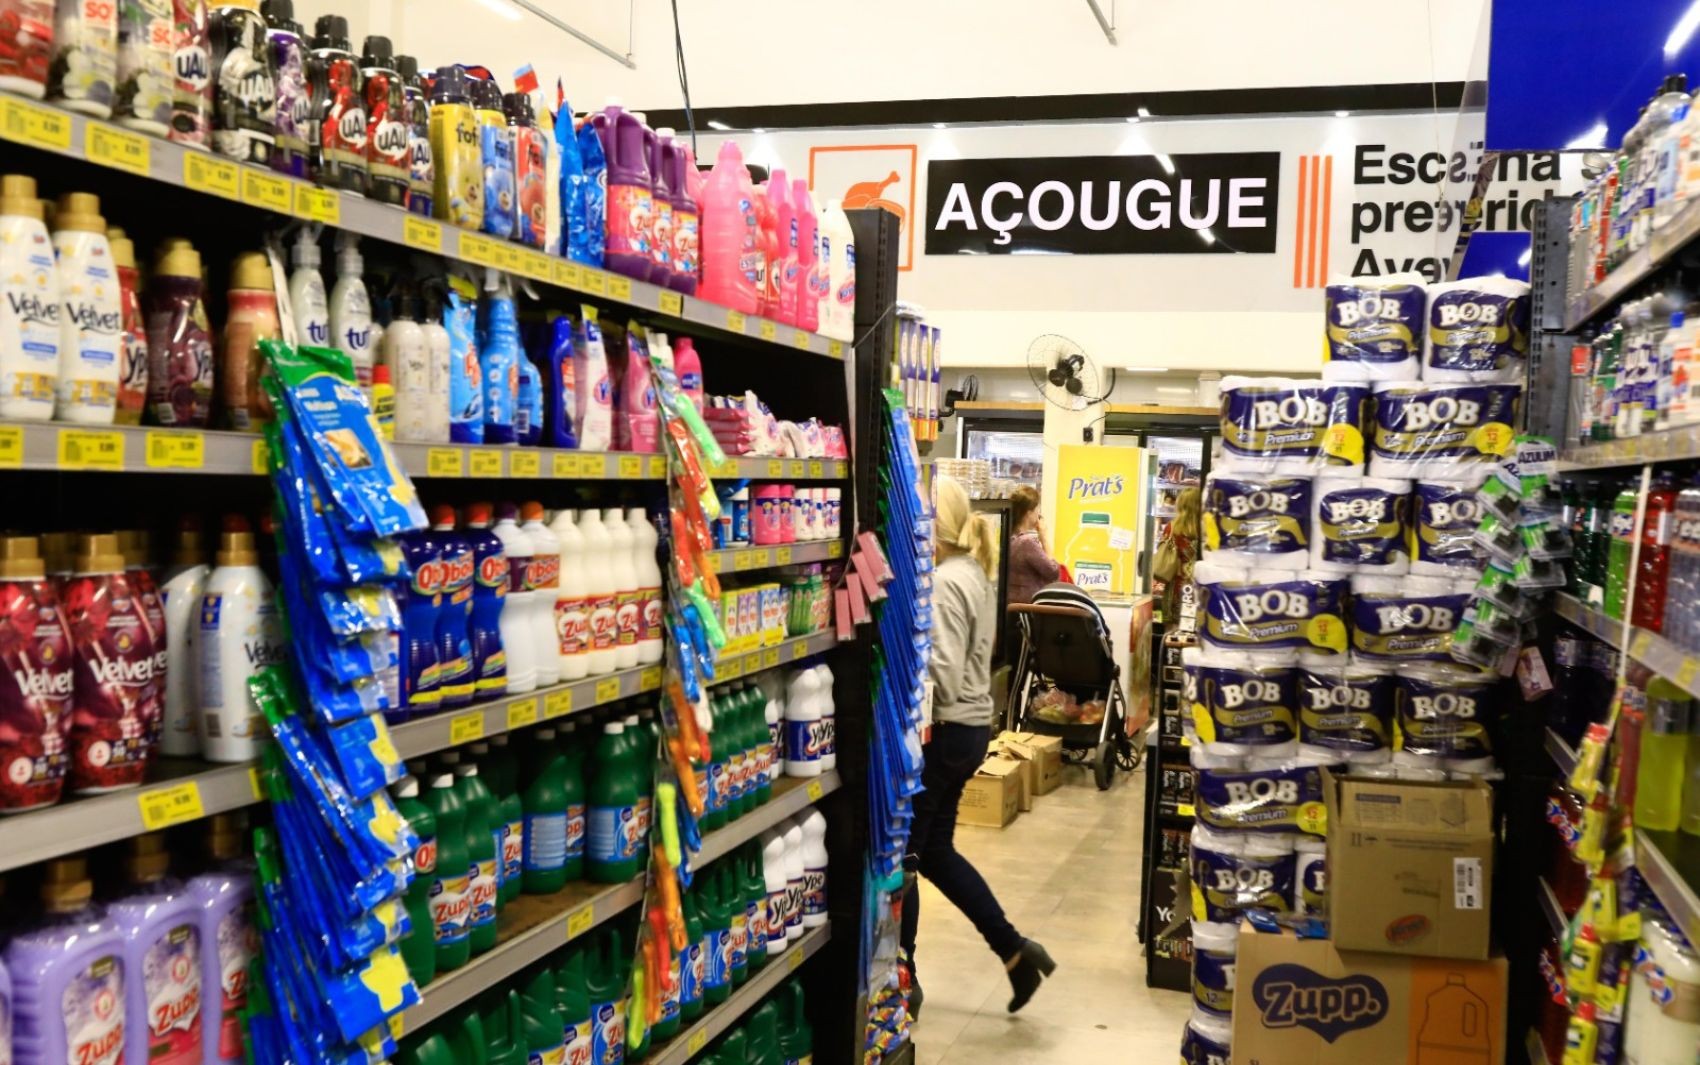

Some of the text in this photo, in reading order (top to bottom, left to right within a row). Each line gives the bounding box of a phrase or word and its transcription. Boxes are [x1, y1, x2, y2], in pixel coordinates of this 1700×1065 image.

[935, 177, 1267, 244] AÇOUGUE
[1337, 297, 1401, 326] BOB
[1439, 302, 1499, 327] BOB
[1254, 396, 1328, 429] BOB
[1402, 396, 1480, 432] BOB
[1264, 431, 1314, 446] Premium
[1068, 475, 1123, 499] Prat's
[1229, 490, 1289, 517] BOB
[1330, 498, 1386, 523] BOB
[1235, 589, 1309, 622] BOB
[1376, 603, 1453, 635] BOB
[1250, 623, 1297, 639] Premium
[89, 654, 153, 684] Velvet
[1221, 680, 1281, 708] BOB
[1311, 685, 1371, 710] BOB
[1413, 694, 1476, 719] BOB
[1225, 778, 1298, 804] BOB
[1214, 866, 1274, 891] BOB
[1264, 982, 1381, 1028] Zupp.
